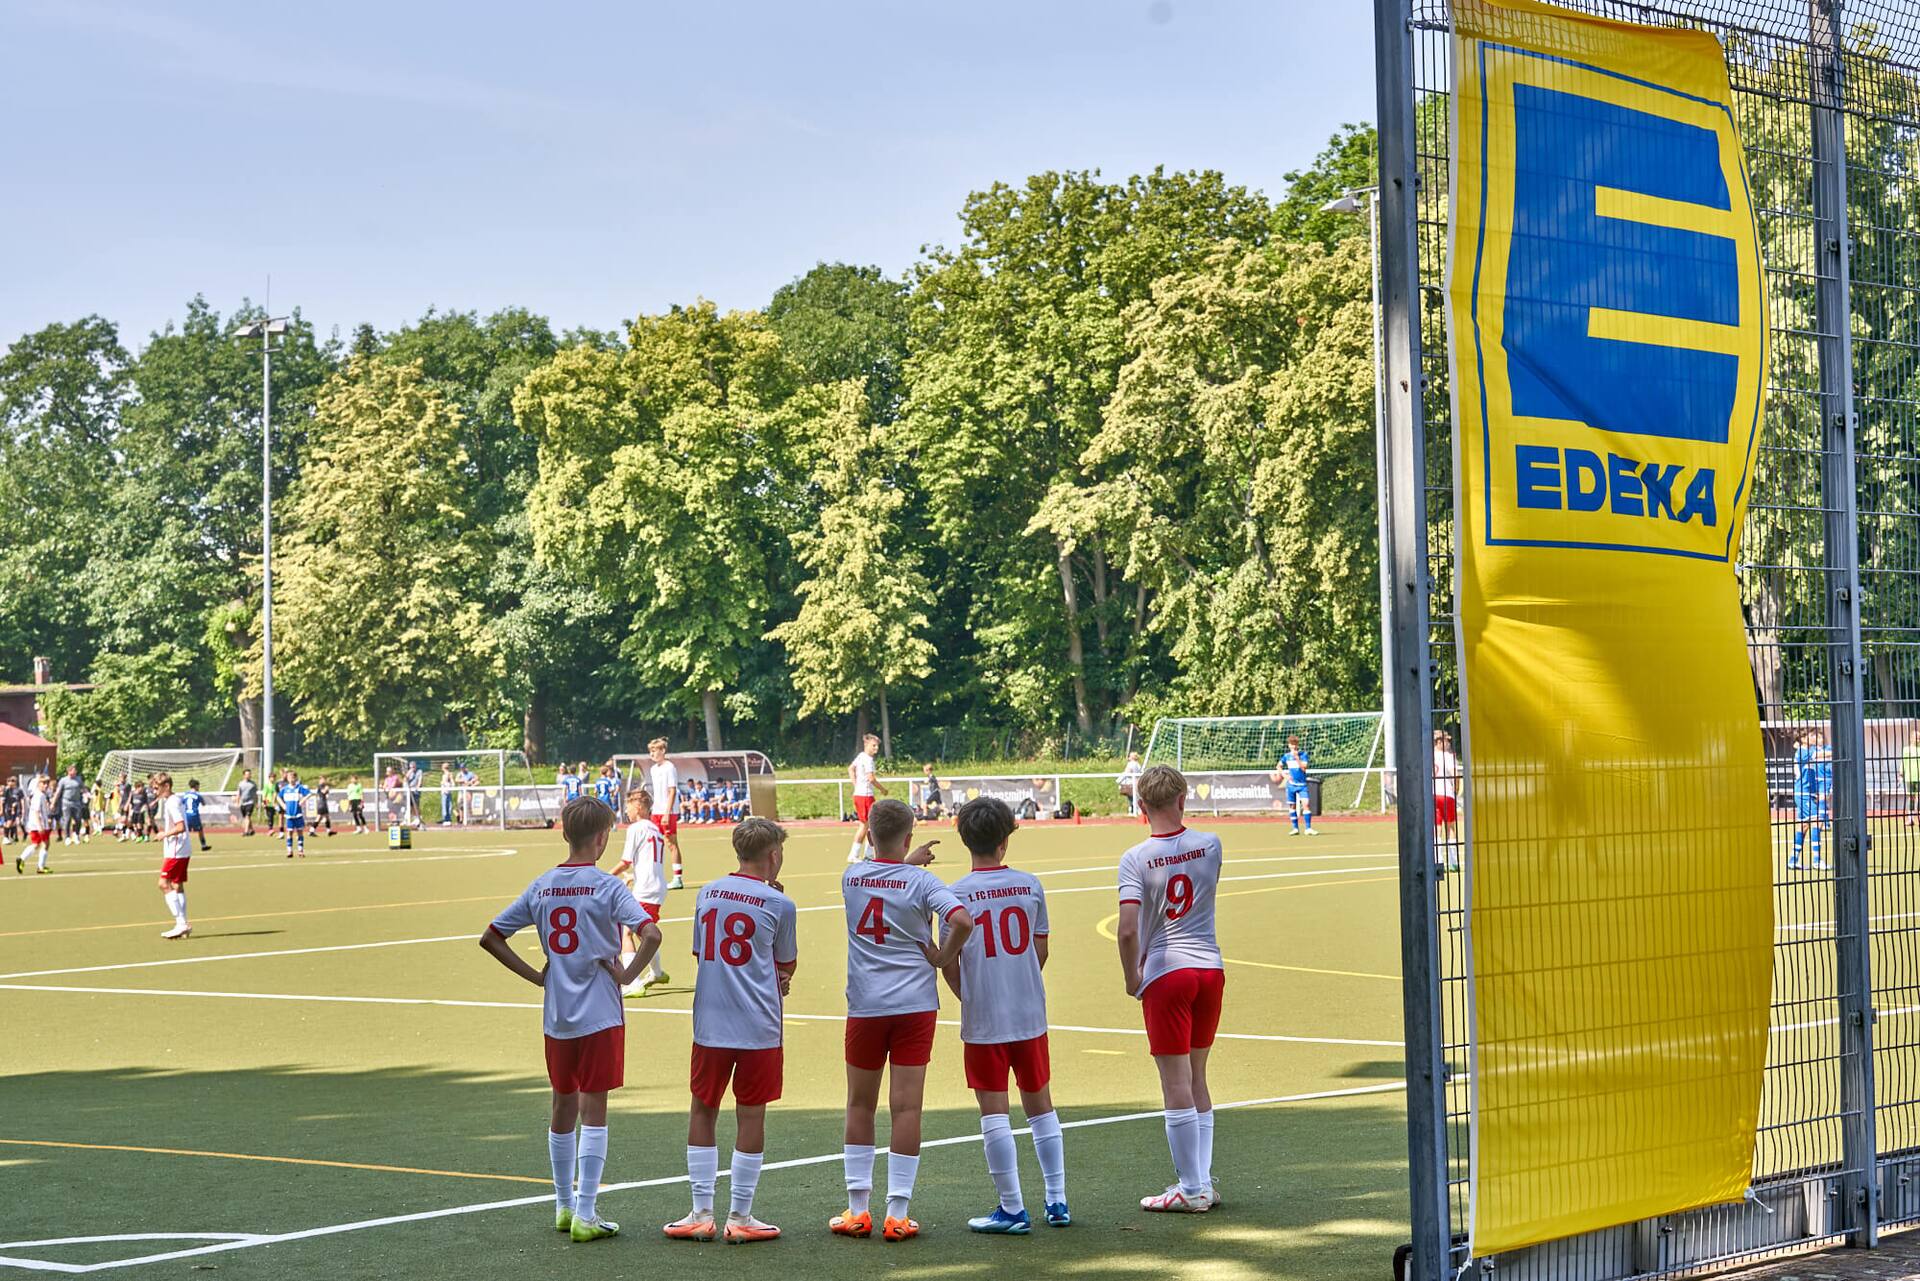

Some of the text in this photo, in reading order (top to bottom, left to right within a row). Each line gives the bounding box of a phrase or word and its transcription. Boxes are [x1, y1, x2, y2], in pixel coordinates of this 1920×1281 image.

[1515, 444, 1717, 527] EDEKA
[647, 835, 665, 864] 17
[1154, 857, 1165, 868] FC
[1165, 848, 1206, 866] FRANKFURT
[542, 888, 551, 897] FC
[551, 886, 596, 897] FRANKFURT
[709, 889, 719, 899] FC
[719, 890, 767, 908] FRANKFURT
[850, 877, 860, 887] FC
[860, 877, 908, 889] FRANKFURT
[968, 886, 1031, 902] 1. FC FRANKFURT
[1165, 873, 1194, 921] 9
[548, 906, 579, 955] 8
[701, 907, 757, 967] 18
[856, 896, 891, 945] 4
[974, 905, 1030, 959] 10
